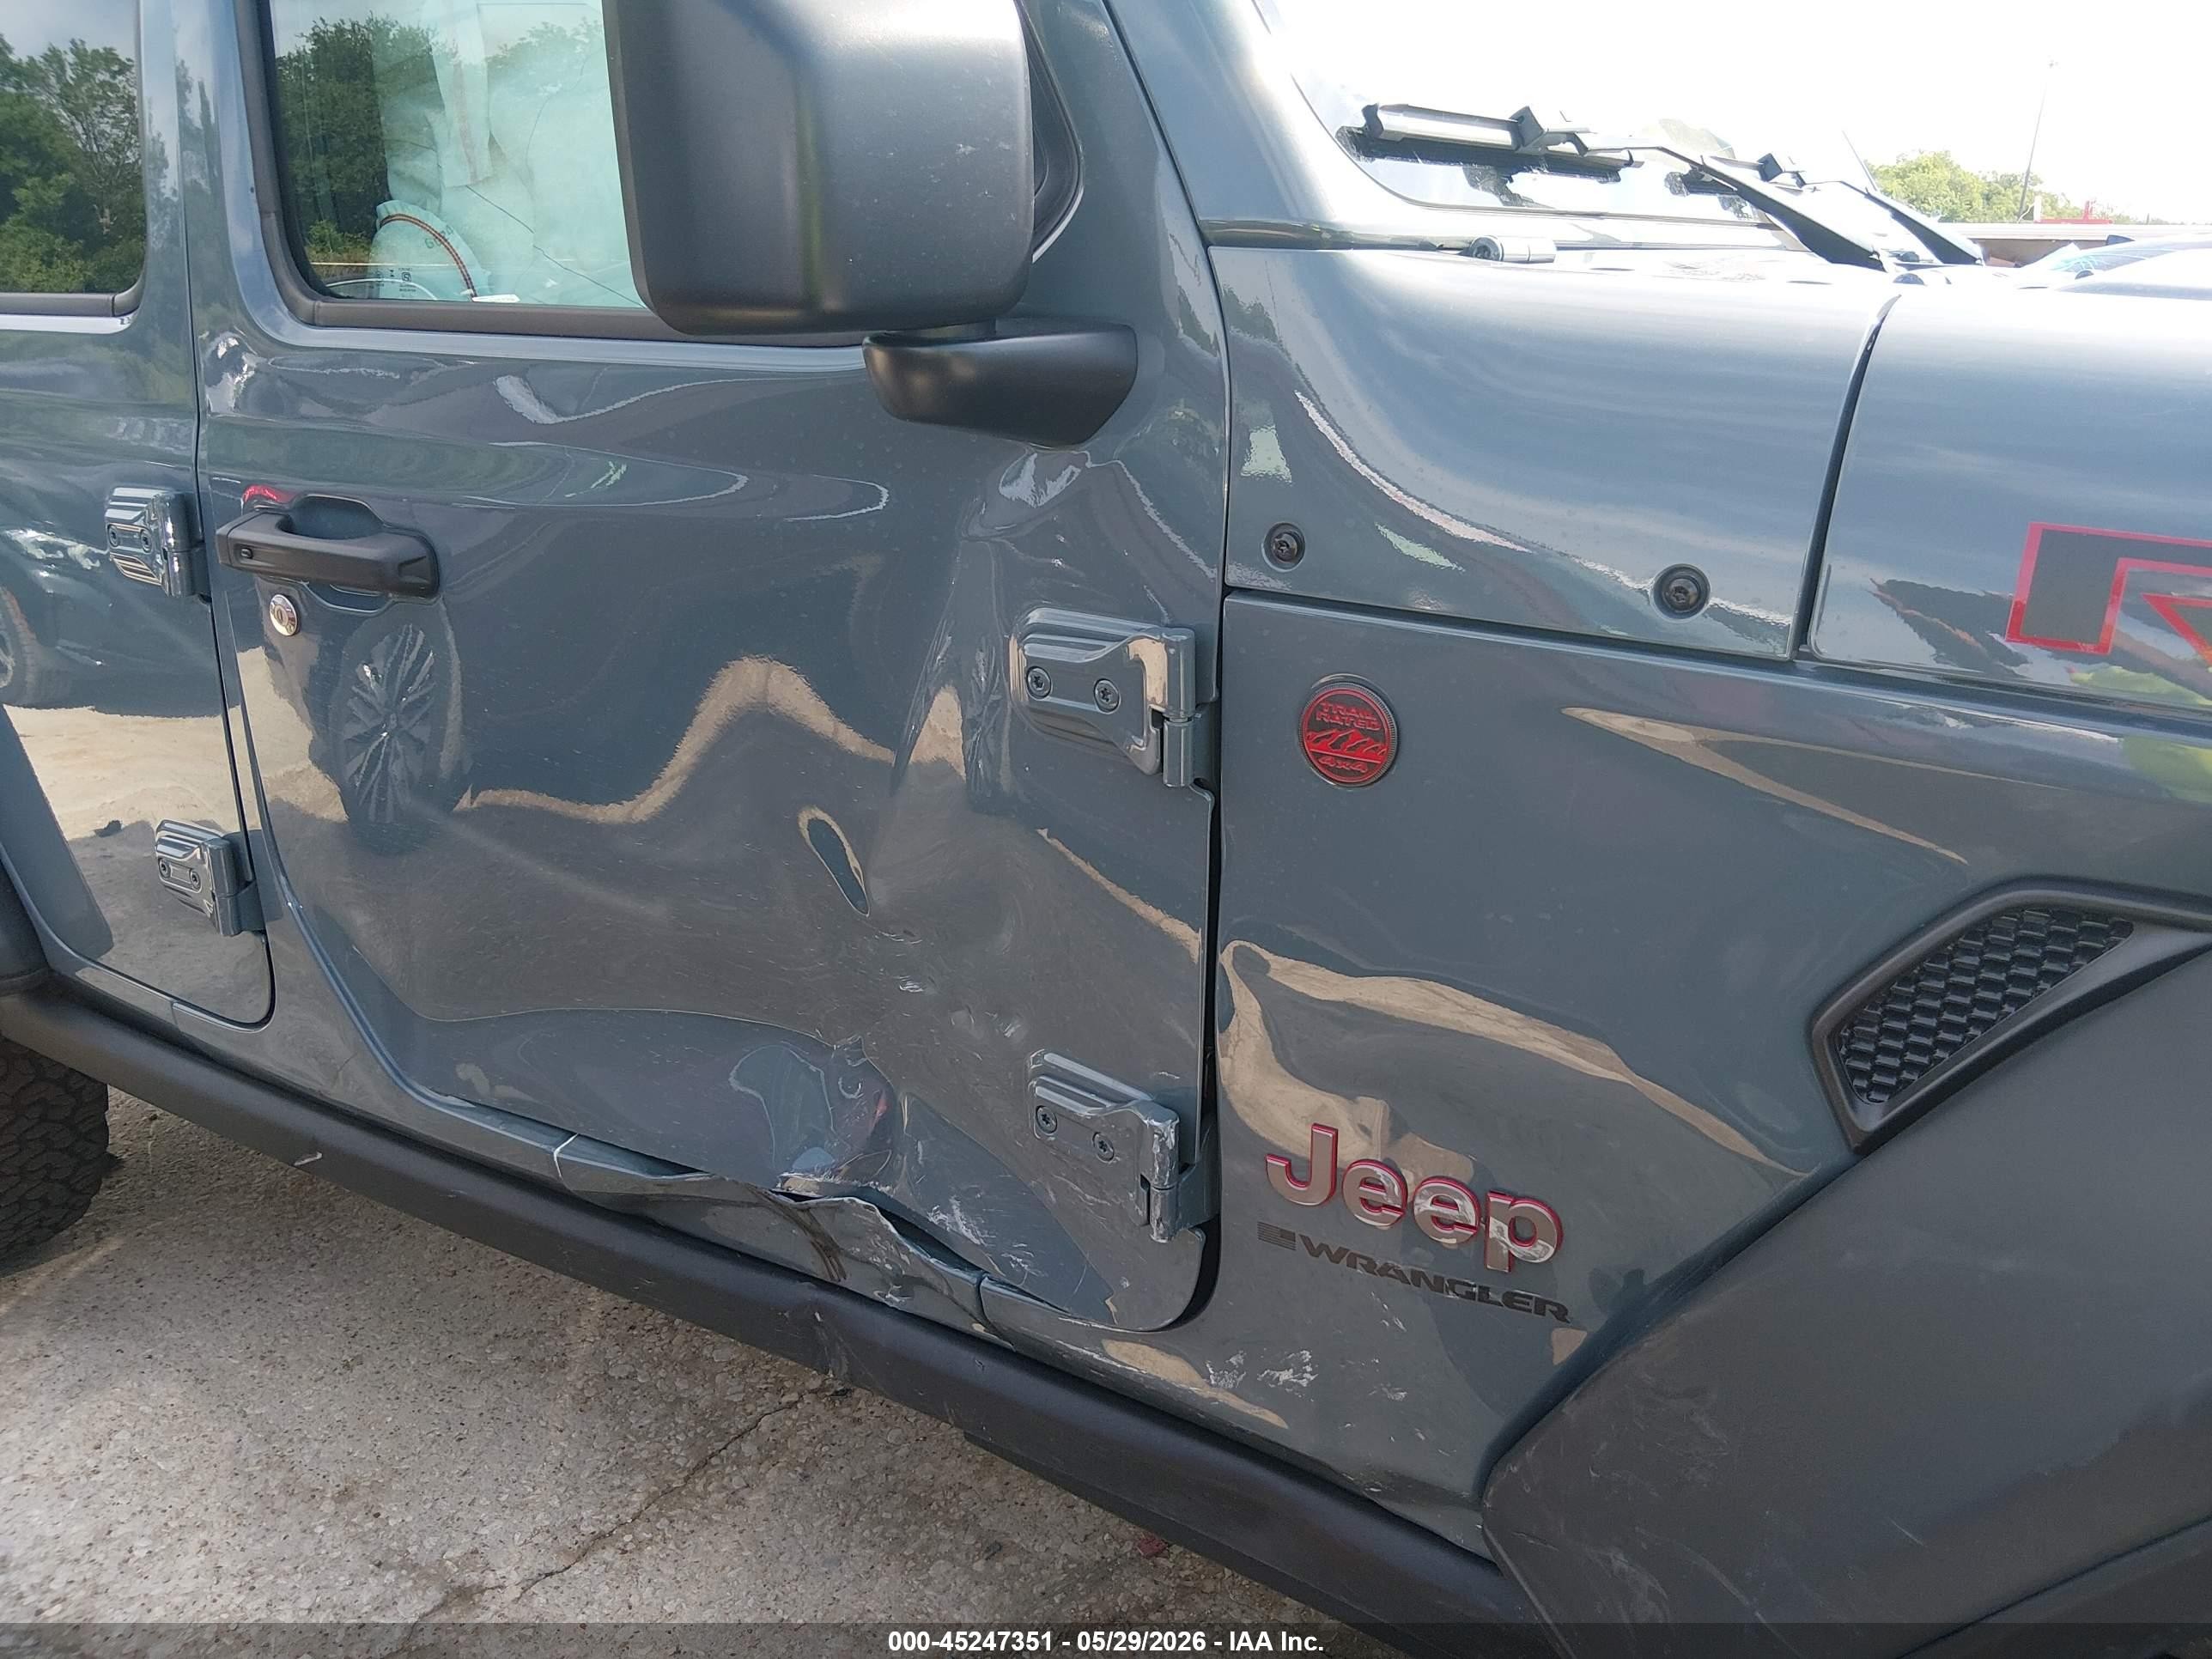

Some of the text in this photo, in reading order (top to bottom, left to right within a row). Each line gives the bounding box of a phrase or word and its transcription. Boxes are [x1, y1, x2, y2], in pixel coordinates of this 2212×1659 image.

[1316, 711, 1382, 732] RATED
[1319, 701, 1377, 721] TRAIL
[1265, 1122, 1564, 1273] Jeep
[1299, 1233, 1571, 1323] WRANGLER
